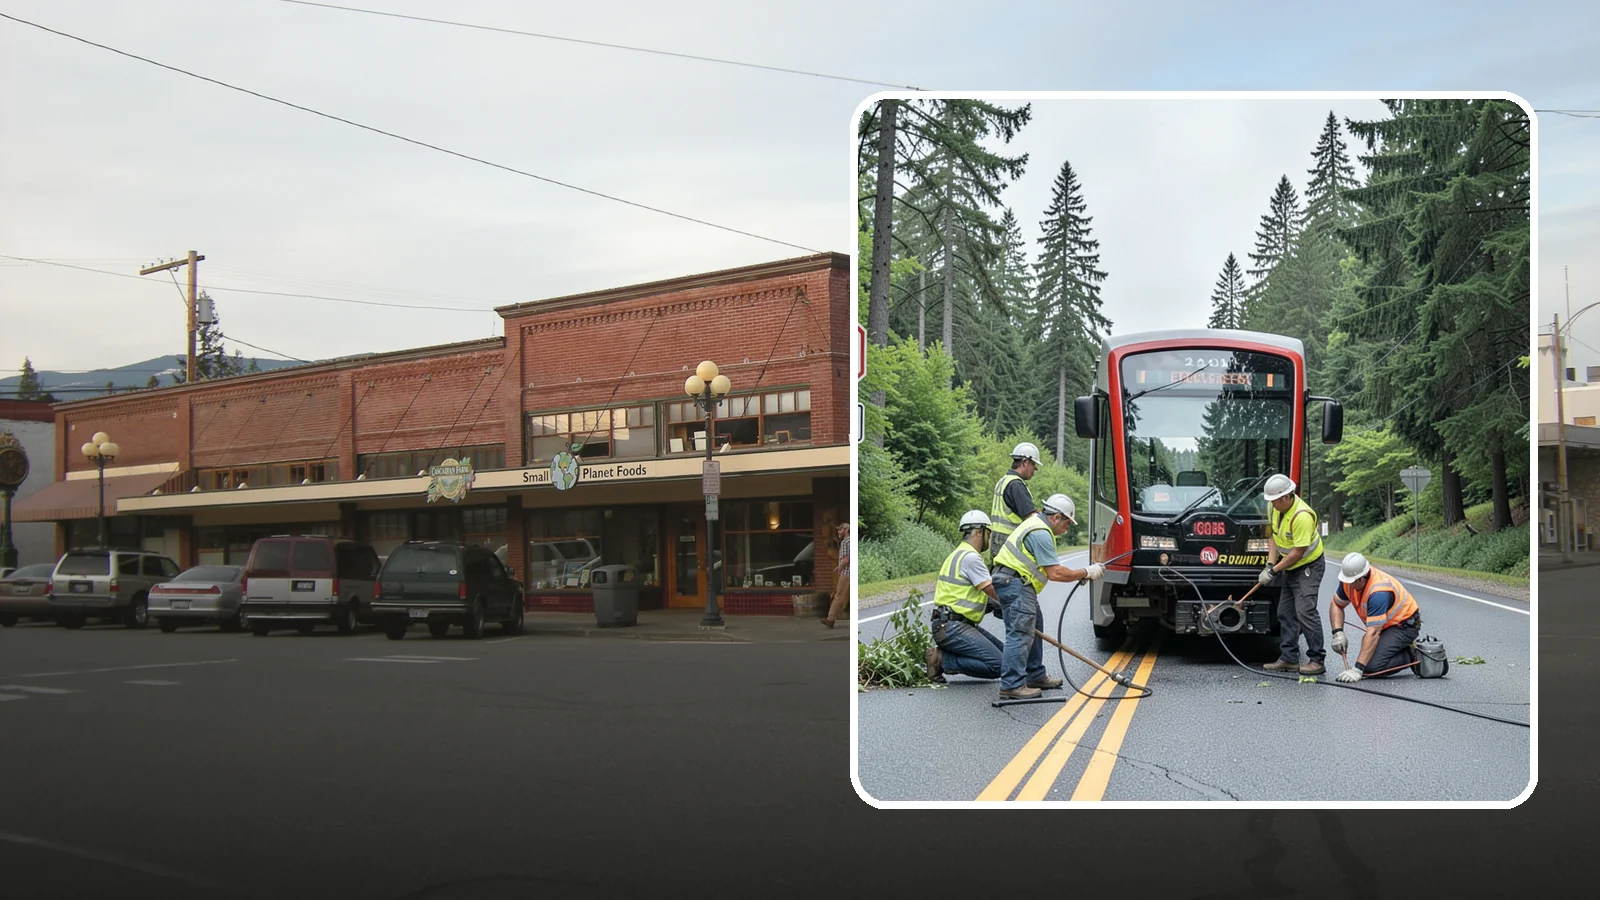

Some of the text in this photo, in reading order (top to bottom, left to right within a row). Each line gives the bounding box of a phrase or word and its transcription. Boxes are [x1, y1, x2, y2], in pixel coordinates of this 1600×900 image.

[523, 465, 647, 483] Small Planet Foods
